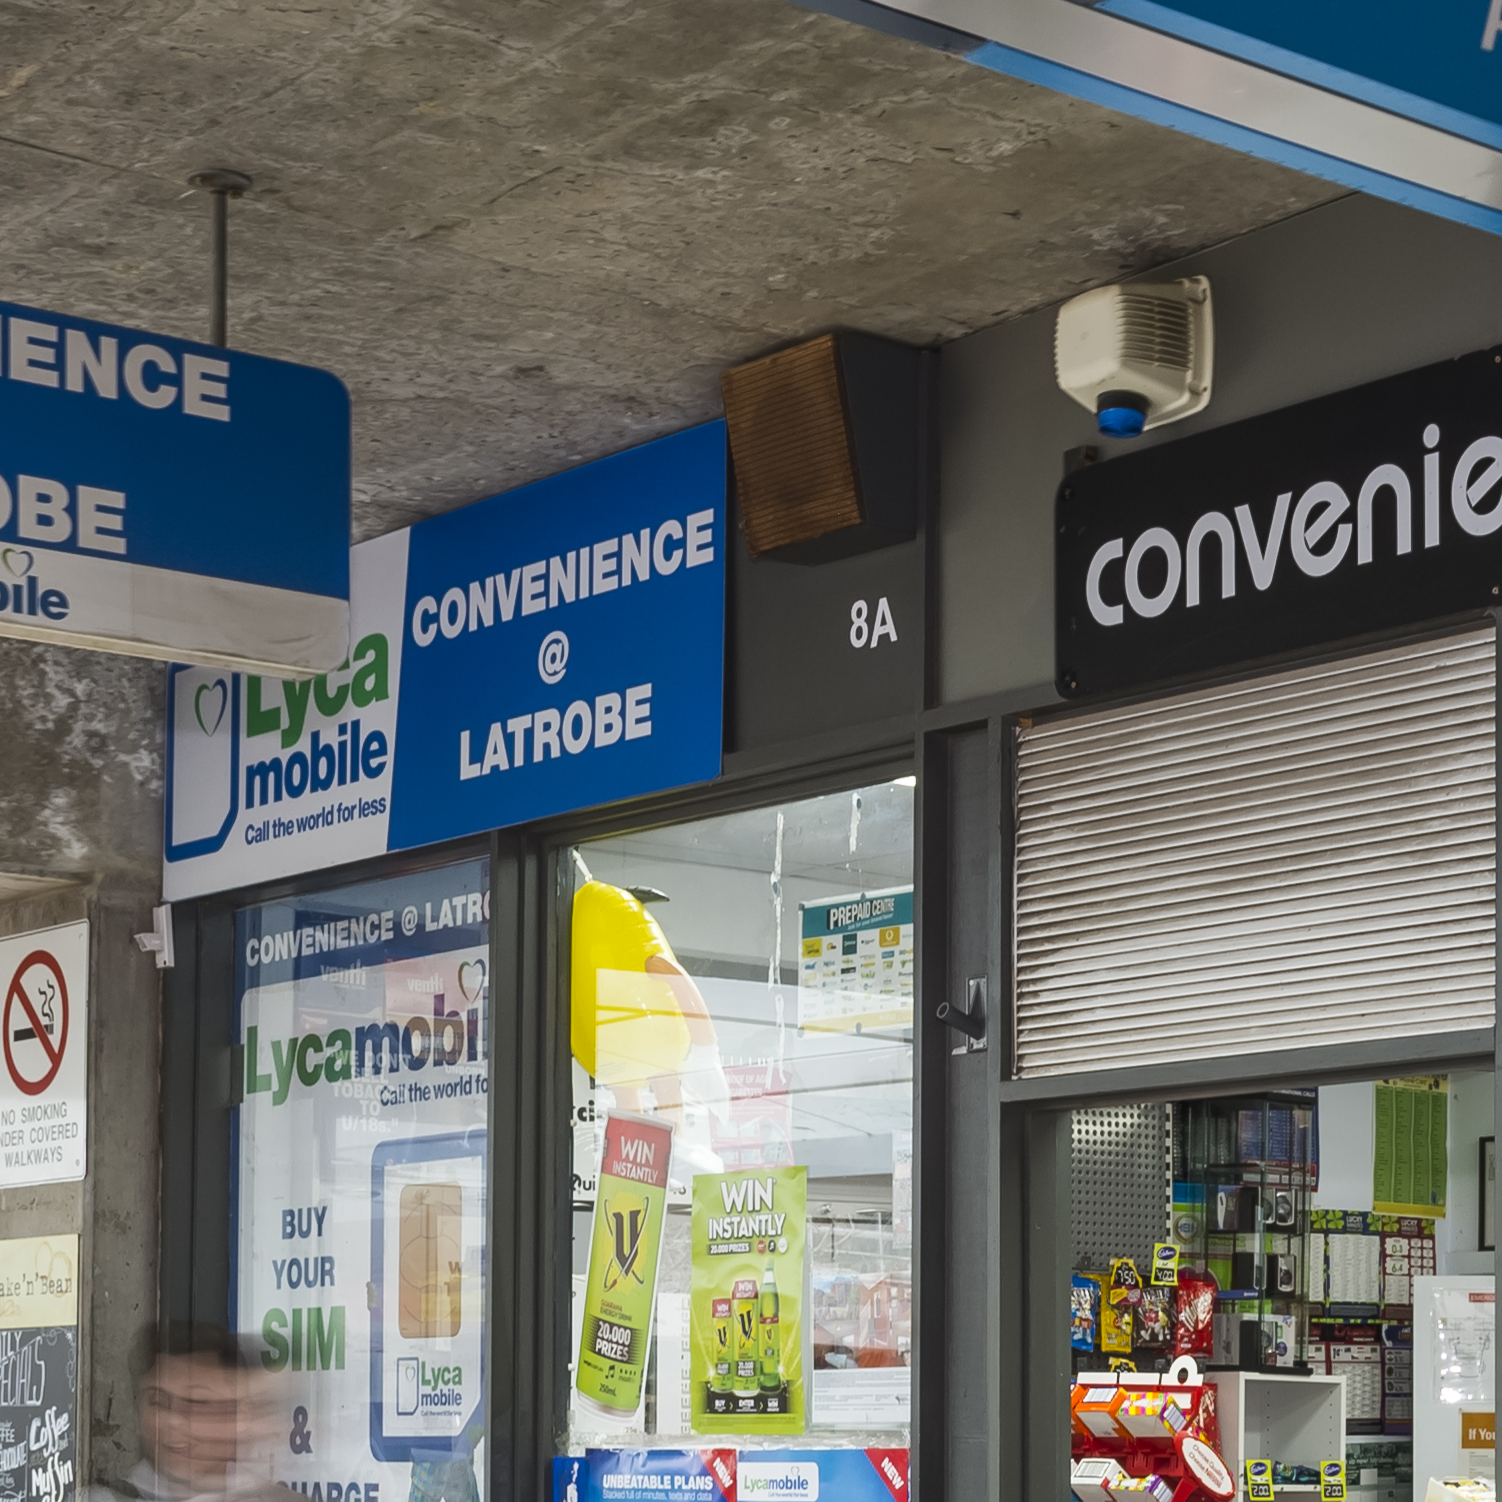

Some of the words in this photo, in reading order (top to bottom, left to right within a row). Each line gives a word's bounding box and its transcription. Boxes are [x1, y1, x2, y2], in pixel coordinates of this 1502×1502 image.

[412, 508, 715, 647] CONVENIENCE
[850, 597, 898, 649] 8A
[538, 630, 569, 684] @
[459, 683, 652, 781] LATROBE
[245, 719, 388, 810] mobile
[245, 820, 270, 845] Call
[272, 817, 294, 839] the
[296, 804, 334, 833] world
[337, 802, 356, 823] for
[358, 797, 386, 818] less
[829, 903, 871, 930] PREPAID
[245, 910, 394, 967] CONVENIENCE
[401, 906, 417, 937] @
[380, 1083, 405, 1106] Call
[408, 1082, 431, 1103] the
[433, 1076, 473, 1100] world
[1, 1109, 16, 1126] NO
[20, 1101, 67, 1123] SMOKING
[359, 1100, 381, 1116] TO
[30, 1122, 79, 1144] COVERED
[5, 1146, 63, 1168] WALKWAYS
[621, 1135, 656, 1166] WIN
[612, 1160, 659, 1186] INSTANTLY
[282, 1205, 327, 1240] BUY
[708, 1213, 786, 1240] INSTANTLY
[272, 1255, 335, 1289] YOUR
[260, 1306, 346, 1372] SIM
[595, 1339, 630, 1362] PRIZES
[421, 1361, 462, 1392] Lyca
[421, 1388, 462, 1406] mobile
[29, 1406, 70, 1457] Coffee
[289, 1405, 312, 1455] &
[603, 1474, 671, 1489] UNBEATABLE
[674, 1475, 713, 1491] PLANS
[712, 1457, 733, 1488] NEW
[744, 1475, 809, 1493] Lycamobile
[881, 1456, 905, 1490] NEW
